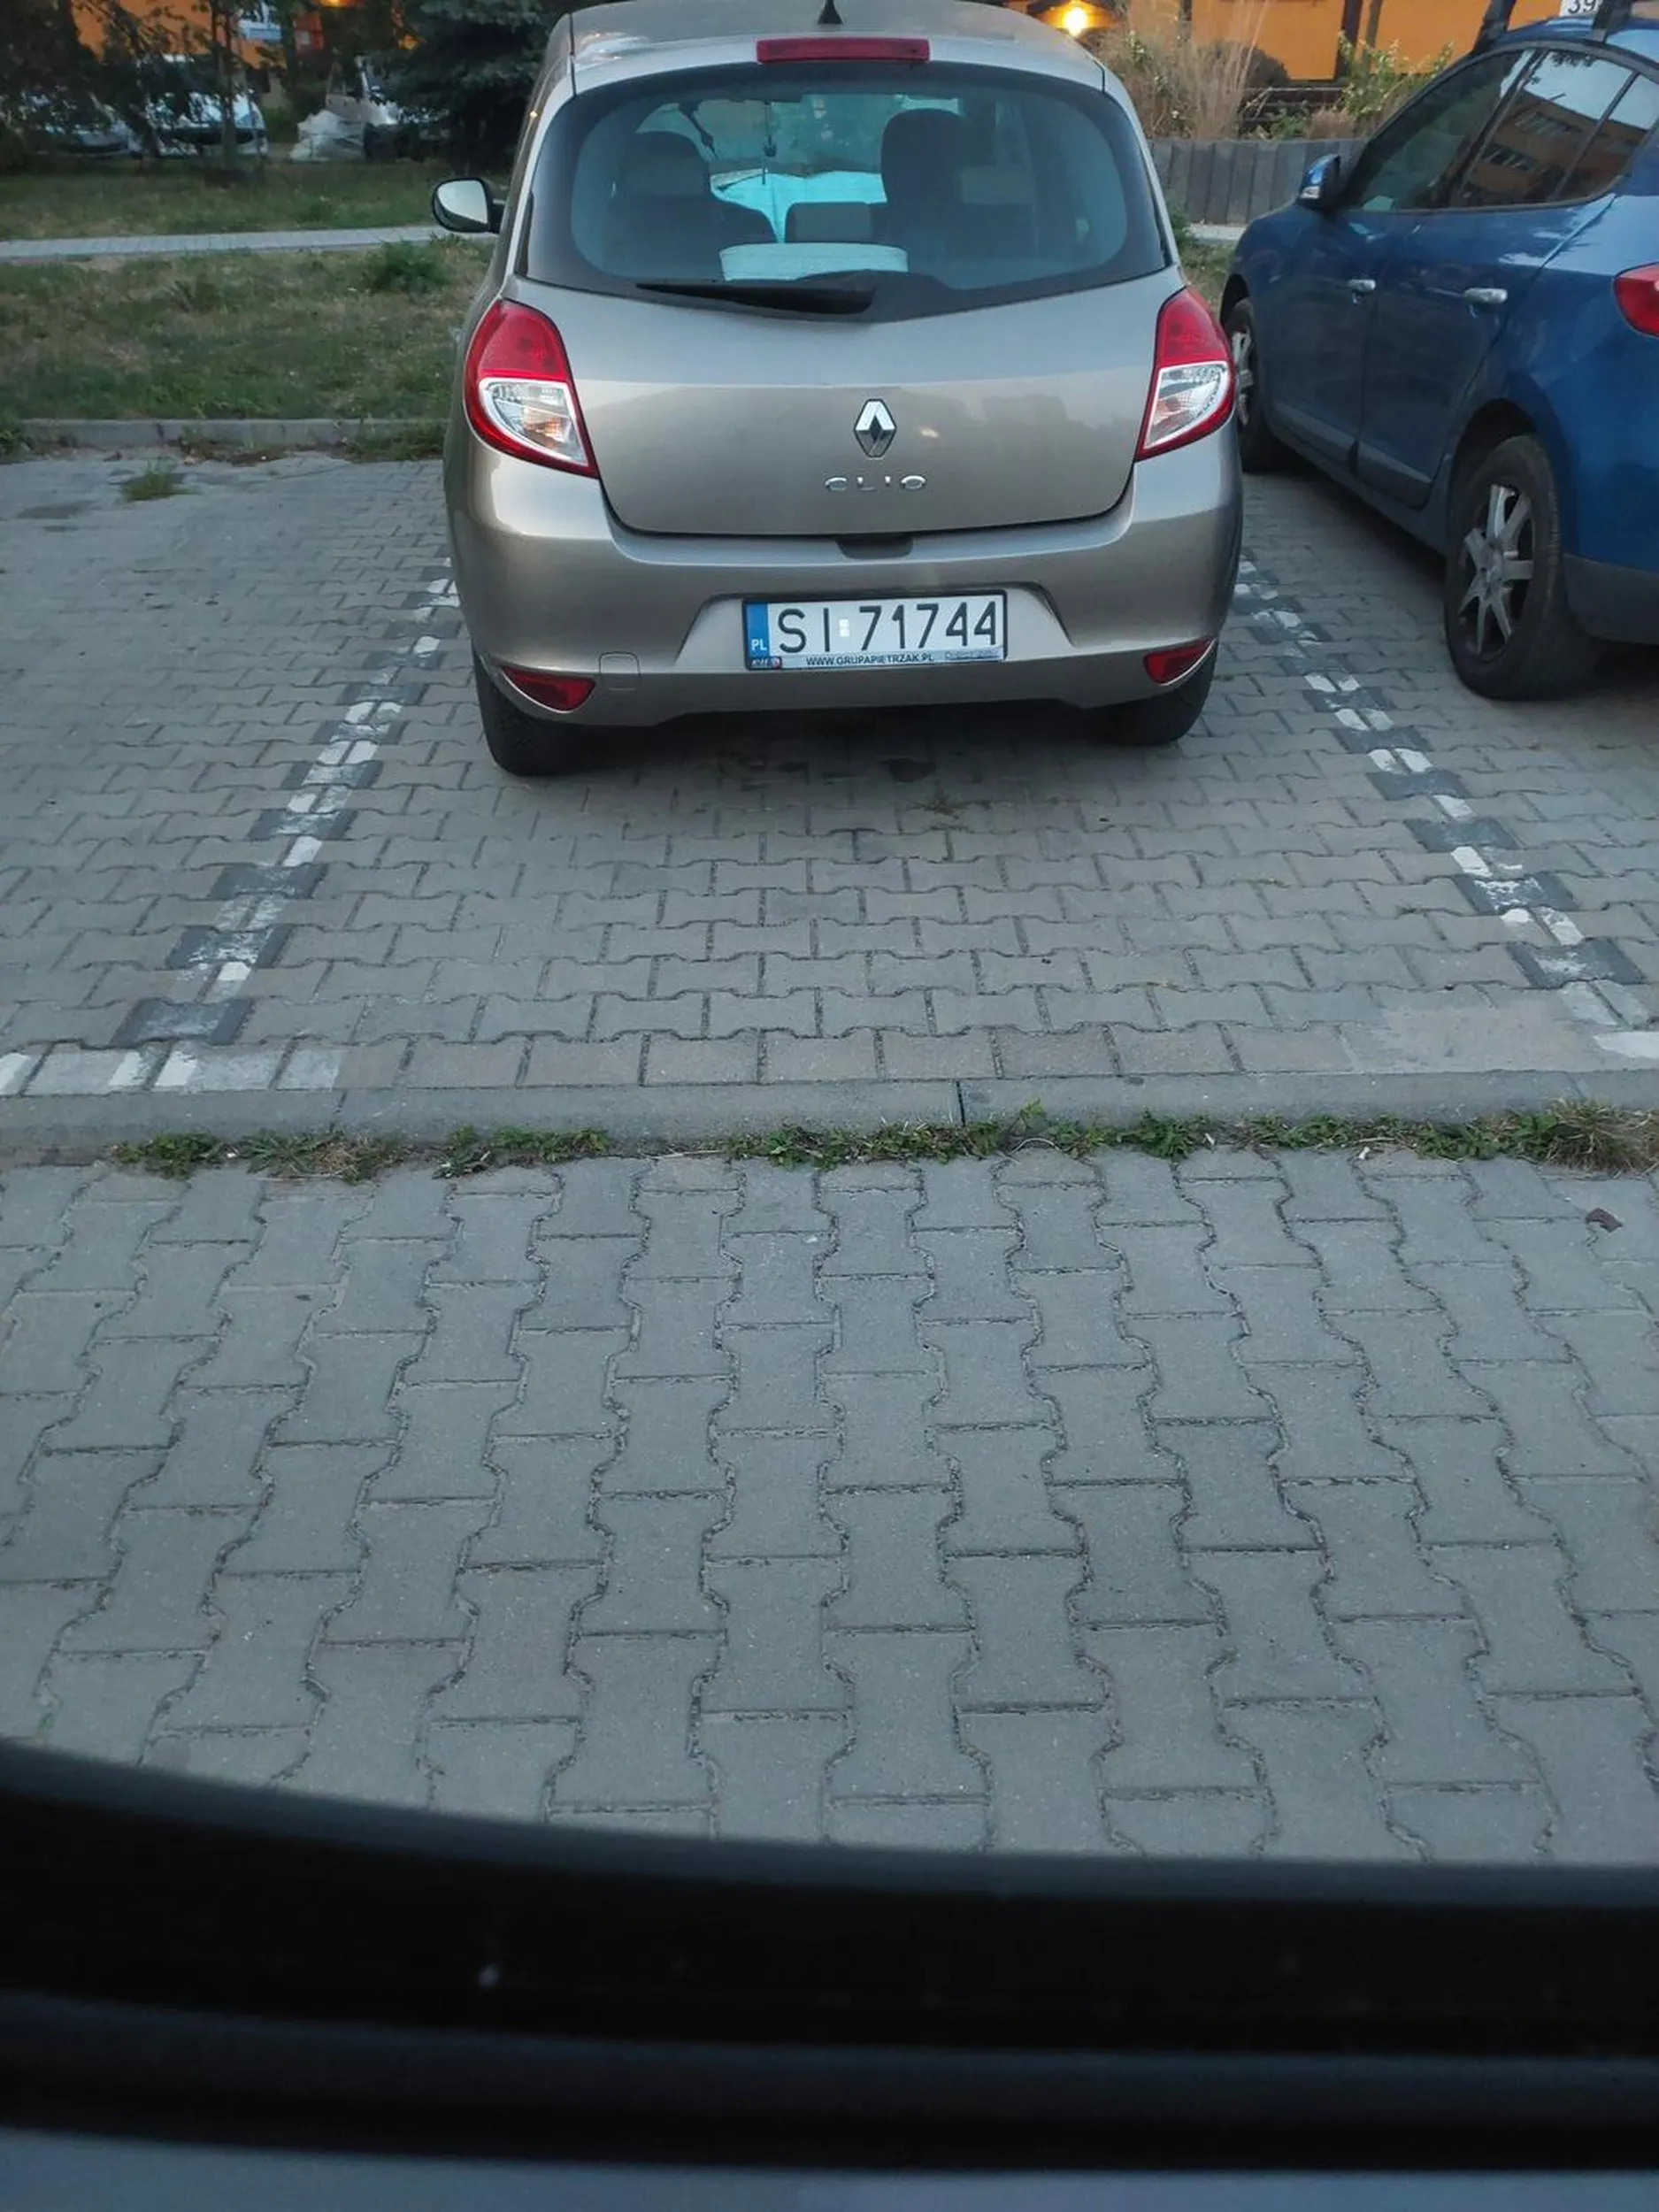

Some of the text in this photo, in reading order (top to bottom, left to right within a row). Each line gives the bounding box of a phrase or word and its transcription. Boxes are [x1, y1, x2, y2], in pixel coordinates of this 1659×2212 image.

[825, 475, 927, 492] CLIO
[777, 600, 996, 653] SI 71744
[751, 638, 767, 651] PL
